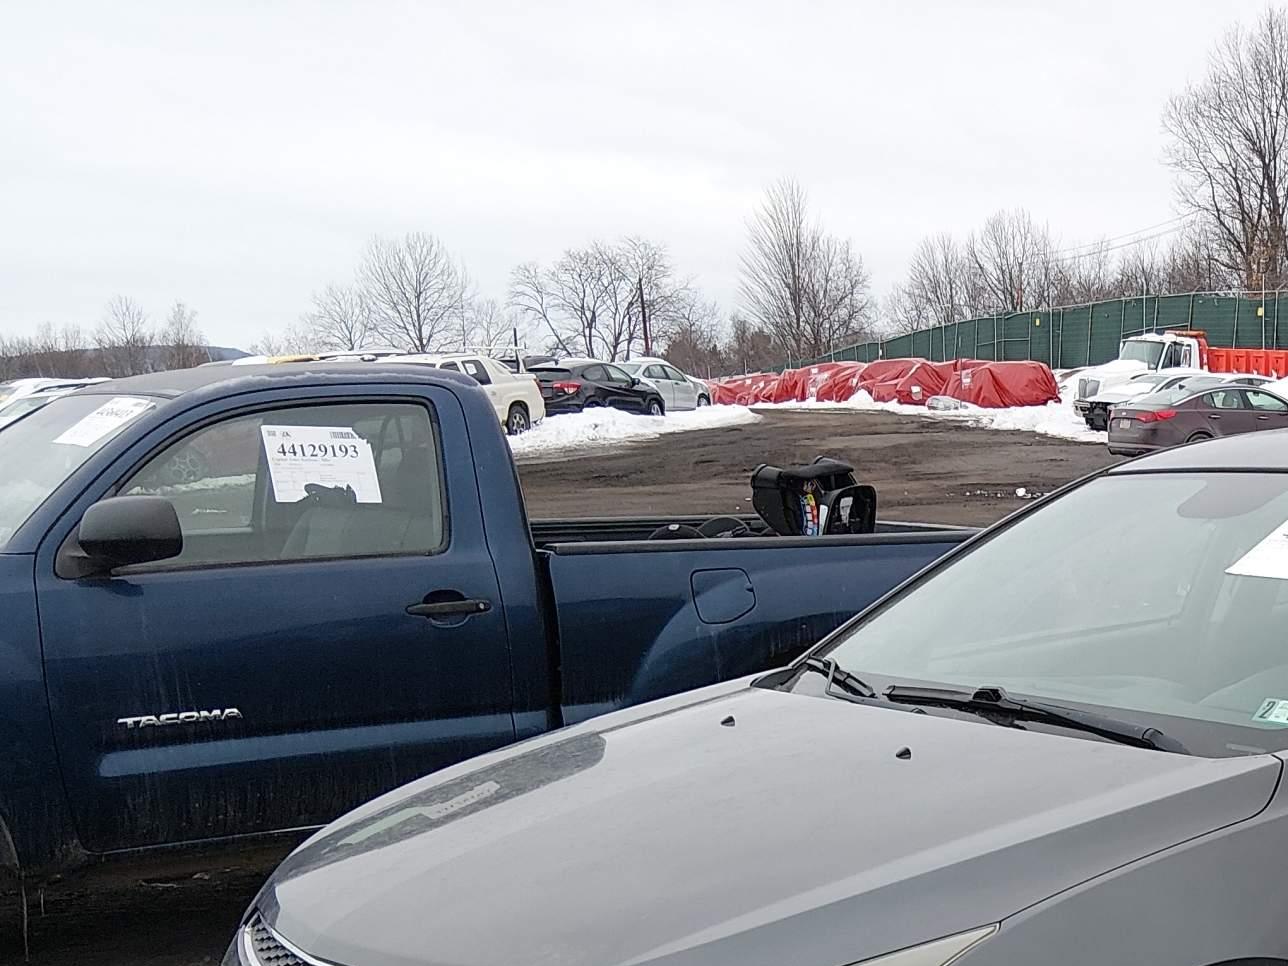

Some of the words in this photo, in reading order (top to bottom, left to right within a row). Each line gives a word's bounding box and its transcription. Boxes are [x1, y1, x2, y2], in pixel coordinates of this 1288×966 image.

[277, 442, 360, 459] 44129193
[117, 707, 244, 729] TACOMA
[1258, 700, 1276, 719] 2
